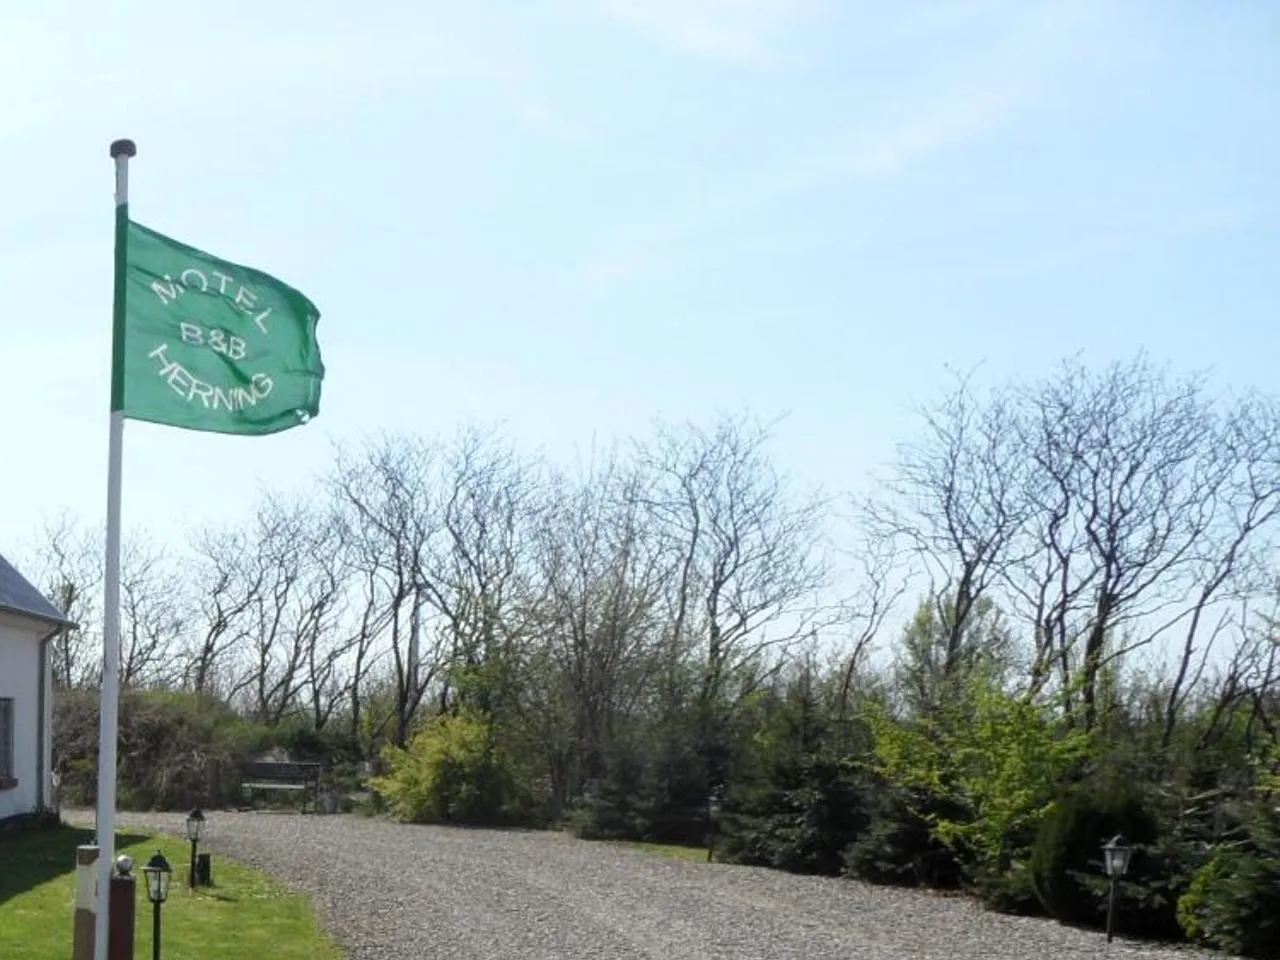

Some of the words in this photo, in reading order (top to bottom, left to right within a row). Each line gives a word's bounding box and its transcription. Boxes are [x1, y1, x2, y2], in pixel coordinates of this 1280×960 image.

[150, 268, 272, 334] MOTEL
[180, 321, 246, 360] B&B
[148, 343, 273, 411] HERNING
